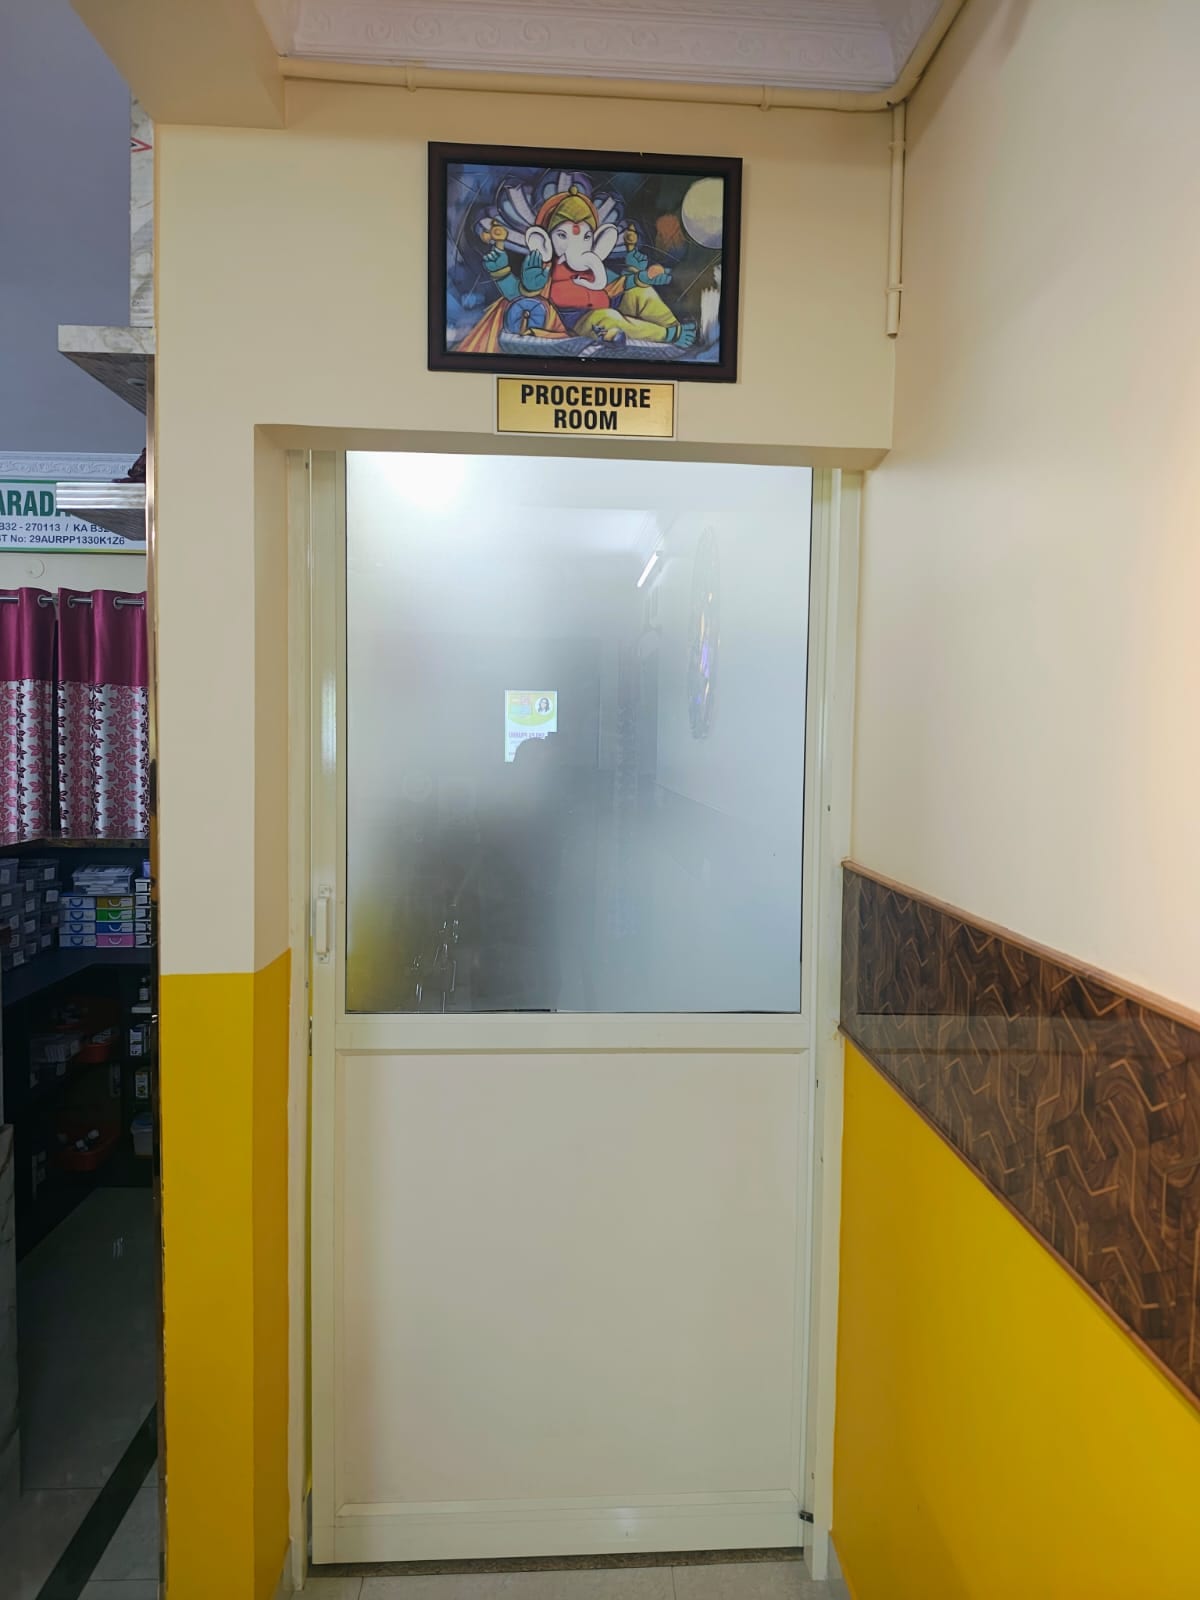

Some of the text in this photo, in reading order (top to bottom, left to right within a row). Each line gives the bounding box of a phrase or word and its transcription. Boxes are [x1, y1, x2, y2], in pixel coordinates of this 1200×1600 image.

[521, 384, 651, 408] PROCEDURE
[554, 409, 617, 430] ROOM
[0, 490, 71, 517] RAD
[25, 522, 61, 532] 270113
[65, 523, 69, 532] /
[73, 523, 88, 533] KA
[10, 534, 27, 543] No:
